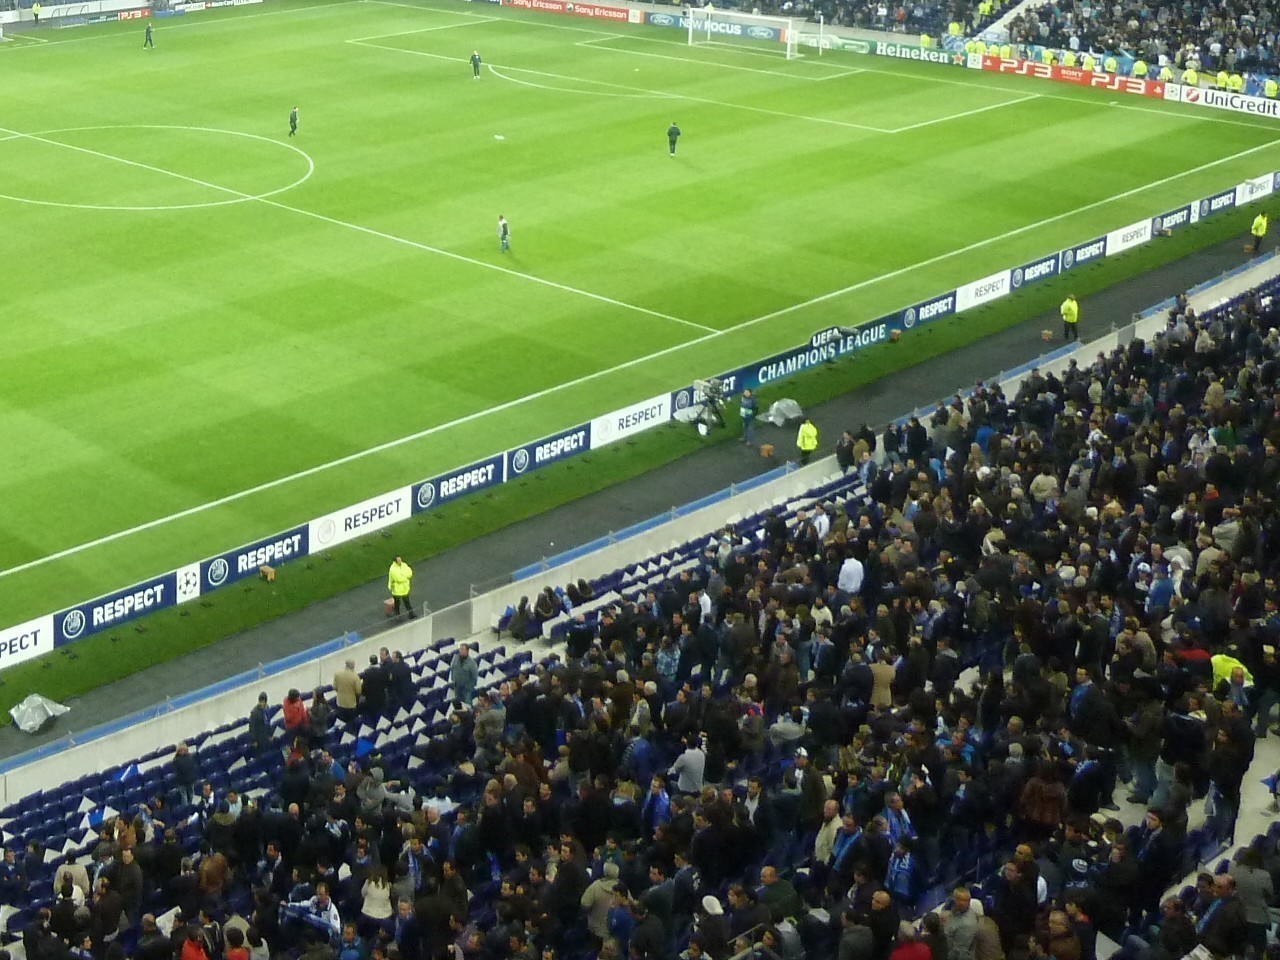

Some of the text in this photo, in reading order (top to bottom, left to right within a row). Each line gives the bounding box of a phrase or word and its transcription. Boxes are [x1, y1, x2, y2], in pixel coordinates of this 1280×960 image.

[121, 11, 141, 21] PS3
[532, 0, 562, 11] Ericsson
[574, 5, 627, 19] Sony Ericsson
[704, 20, 742, 35] FOCUS
[876, 41, 949, 64] Heineken
[999, 57, 1052, 79] PS3
[1091, 72, 1146, 95] PS3
[1204, 90, 1278, 116] UniCredit
[1211, 192, 1235, 211] RESPECT
[1162, 209, 1189, 230] RESPECT
[1121, 225, 1148, 245] RESPECT
[1075, 241, 1105, 262] RESPECT
[1024, 259, 1056, 281] RESPECT
[973, 277, 1005, 299] RESPECT
[919, 296, 954, 321] RESPECT
[812, 327, 839, 348] UEFA
[758, 323, 887, 383] CHAMPIONS LEAGUE
[693, 376, 736, 404] RECT
[618, 403, 664, 431] RESPECT
[535, 430, 586, 463] RESPECT
[439, 463, 495, 498] RESPECT
[344, 498, 402, 532] RESPECT
[237, 533, 302, 573] RESPECT
[92, 583, 165, 627] RESPECT
